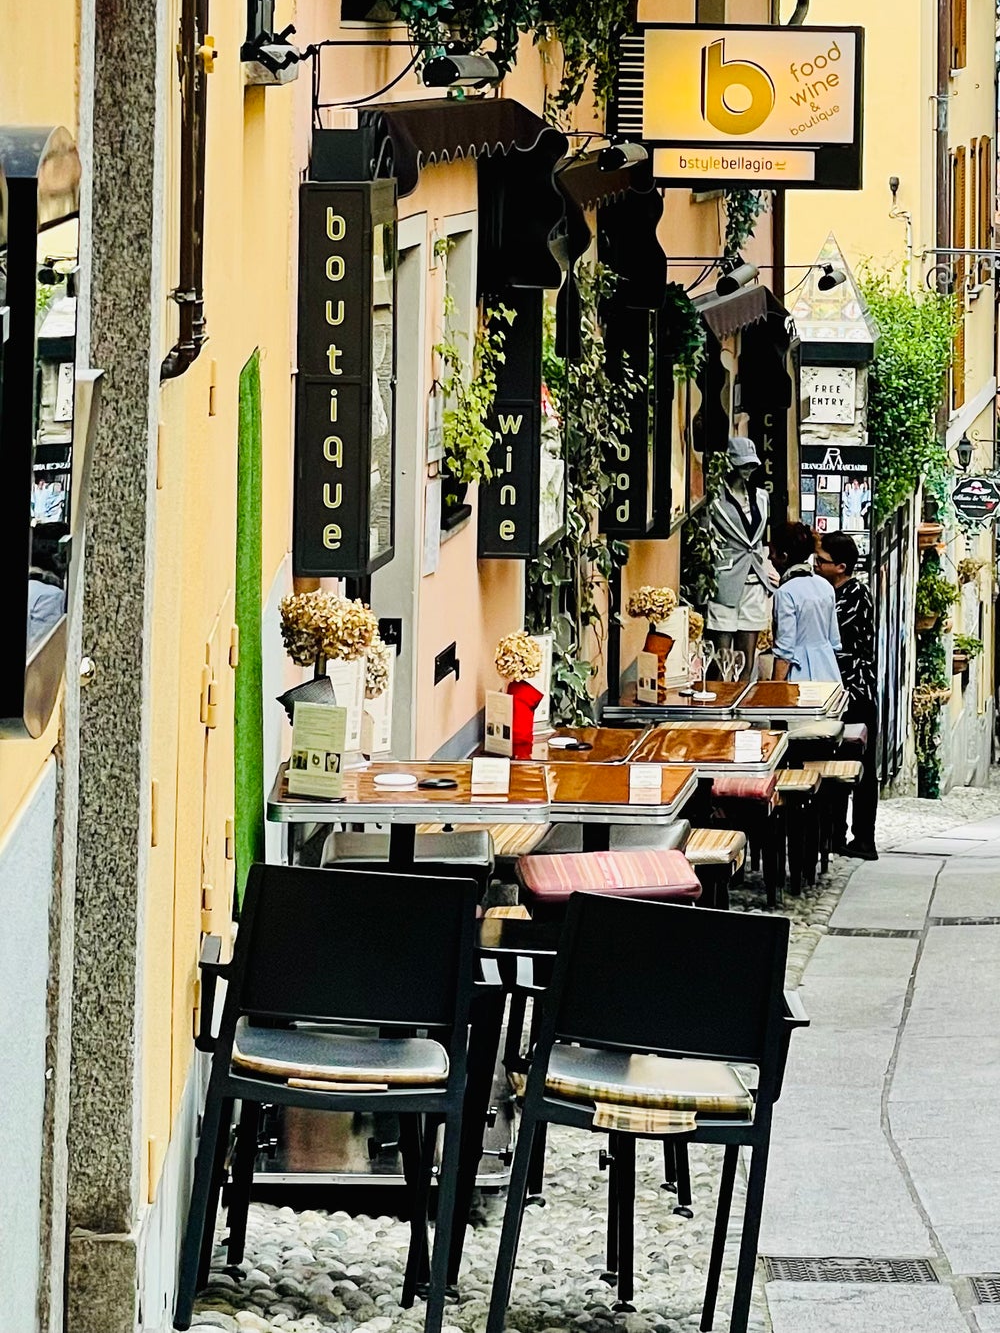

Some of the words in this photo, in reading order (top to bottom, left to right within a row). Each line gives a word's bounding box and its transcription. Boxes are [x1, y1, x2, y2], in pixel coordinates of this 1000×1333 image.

[790, 40, 841, 82] food
[701, 37, 776, 135] b
[789, 73, 839, 107] wine
[789, 105, 840, 136] boutique
[809, 101, 821, 113] &
[322, 207, 347, 550] boutique
[815, 384, 841, 394] FREE
[811, 397, 845, 407] ENTRY
[498, 414, 523, 541] wine
